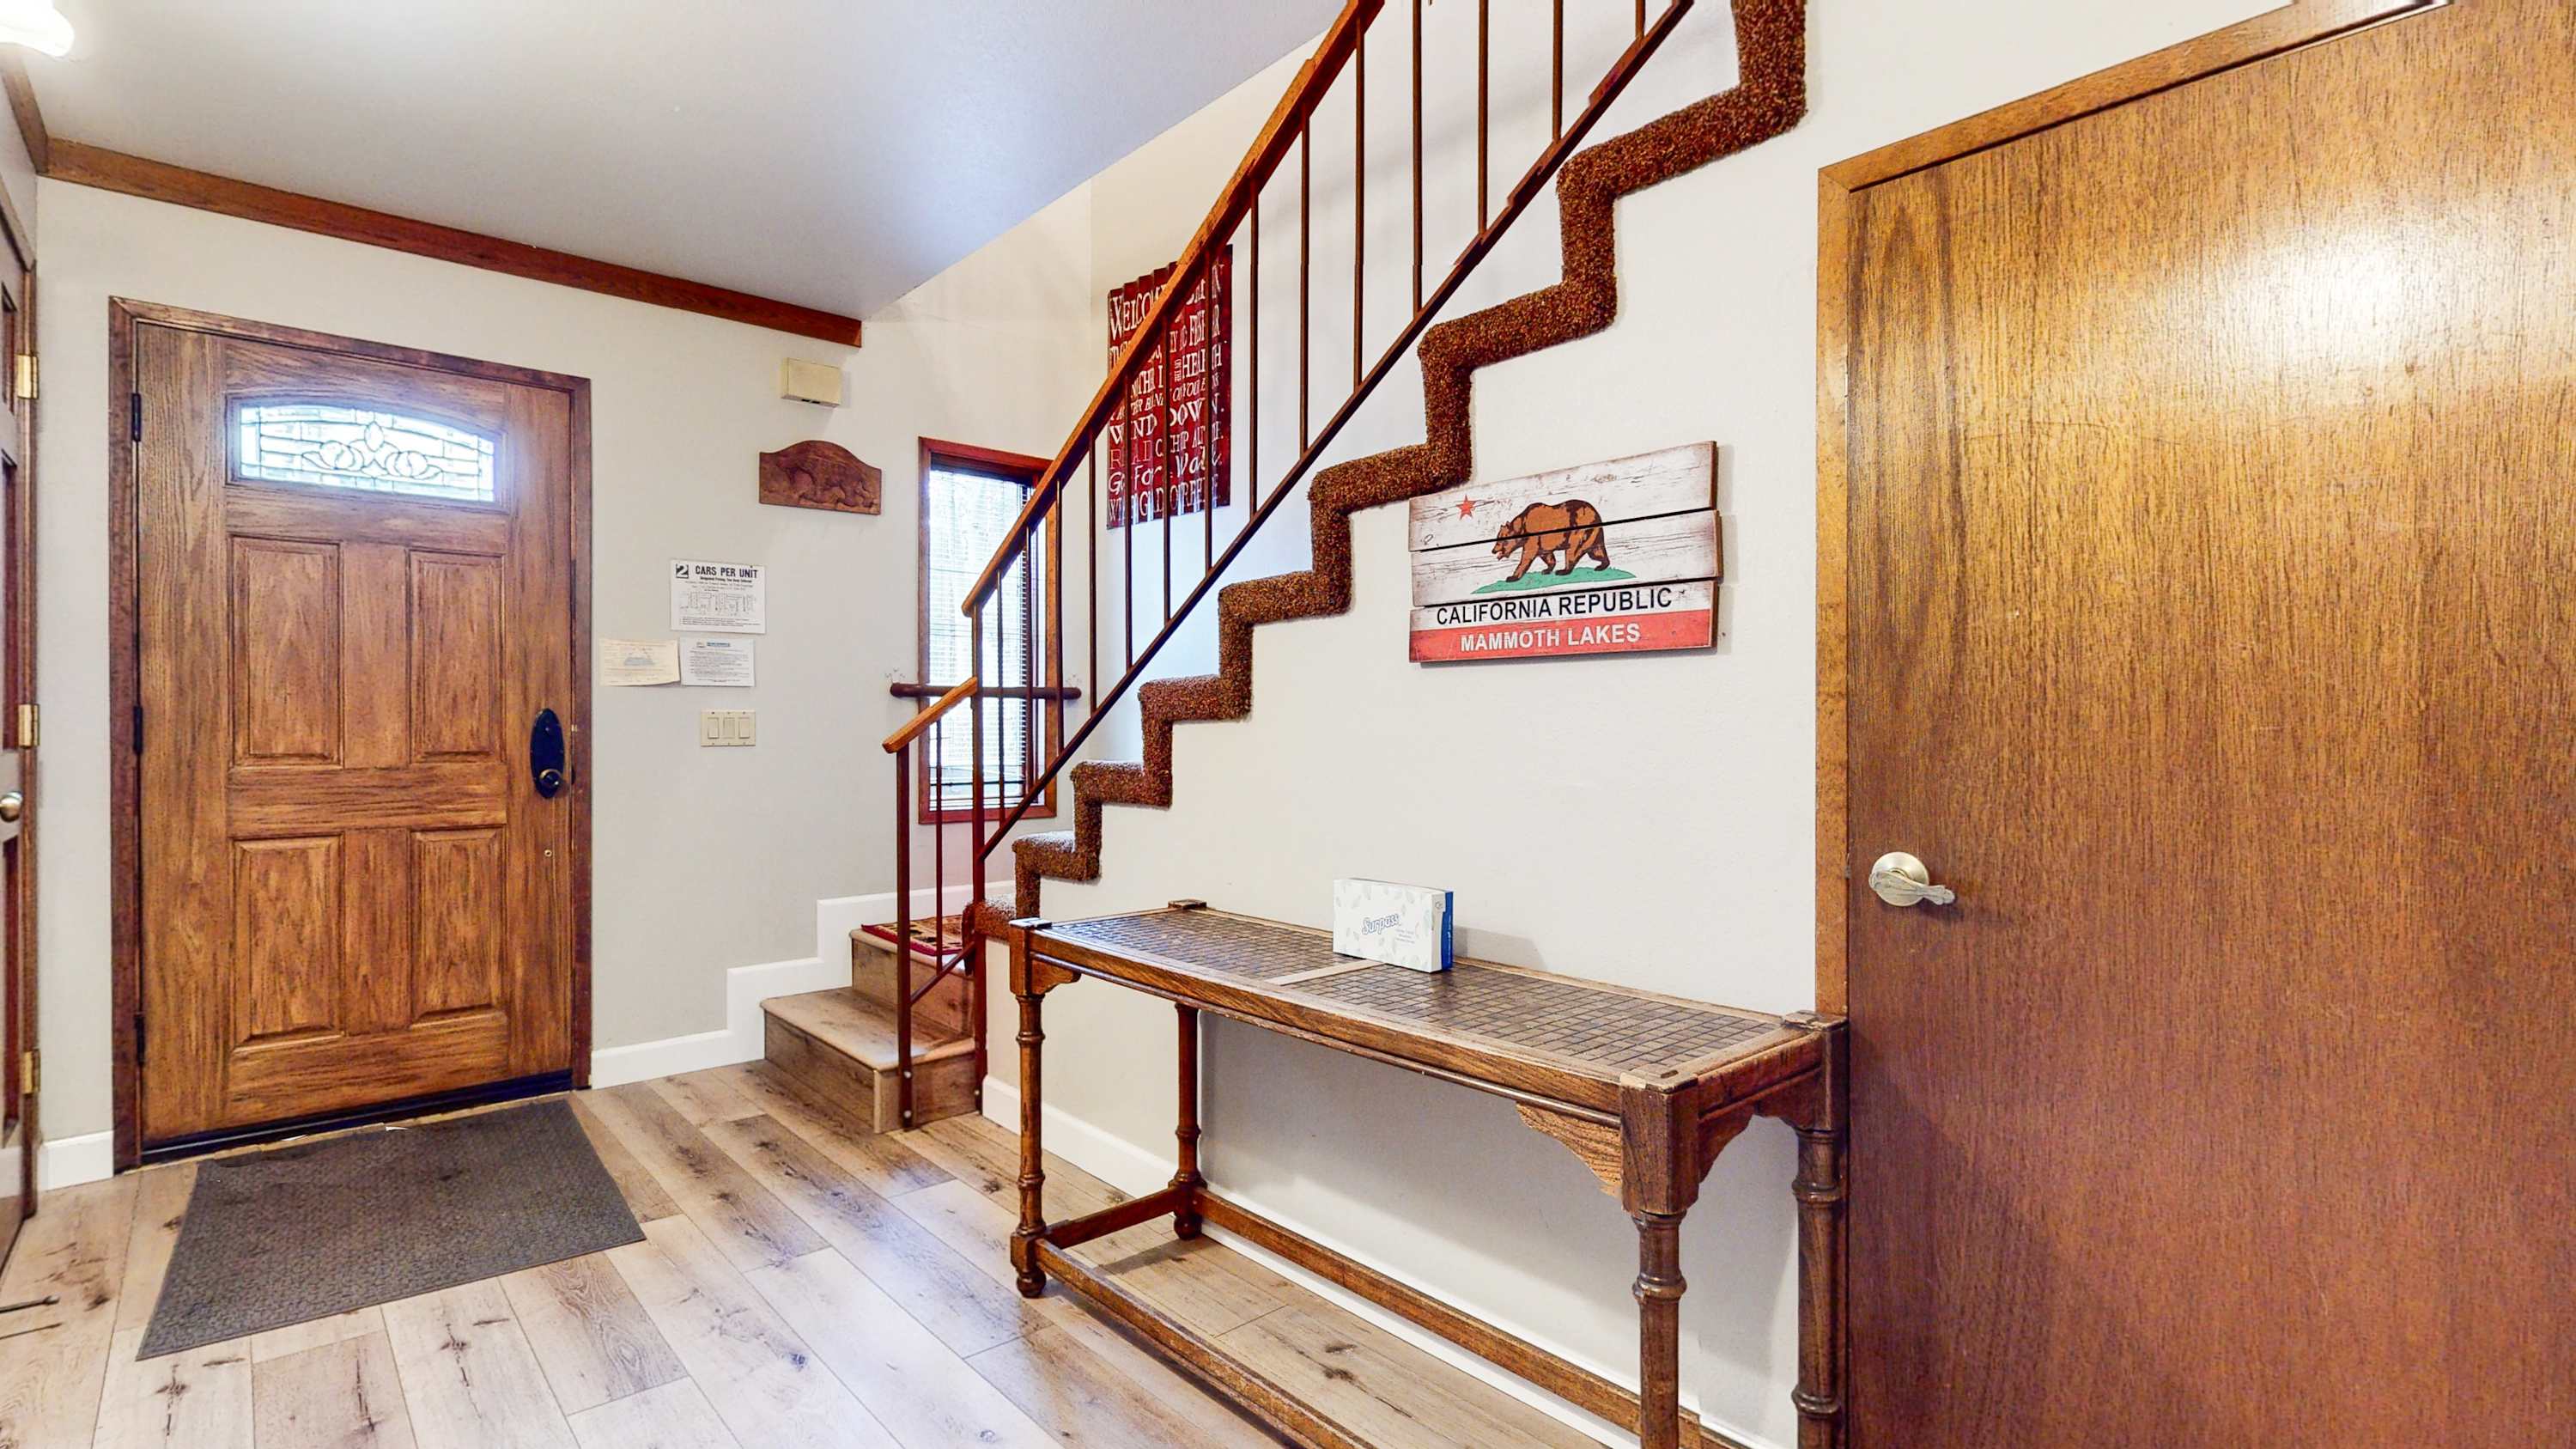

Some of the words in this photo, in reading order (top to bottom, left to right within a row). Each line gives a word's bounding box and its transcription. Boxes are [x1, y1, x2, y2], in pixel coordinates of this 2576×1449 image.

[1110, 284, 1169, 342] WELCO
[1109, 413, 1157, 444] WND
[695, 565, 717, 576] CARS
[720, 567, 736, 577] PER
[738, 569, 759, 579] UNIT
[1437, 600, 1552, 625] CALIFORNIA
[1558, 588, 1673, 616] REPUBLIC
[1461, 629, 1560, 652] MAMMOTH
[1567, 623, 1641, 646] LAKES
